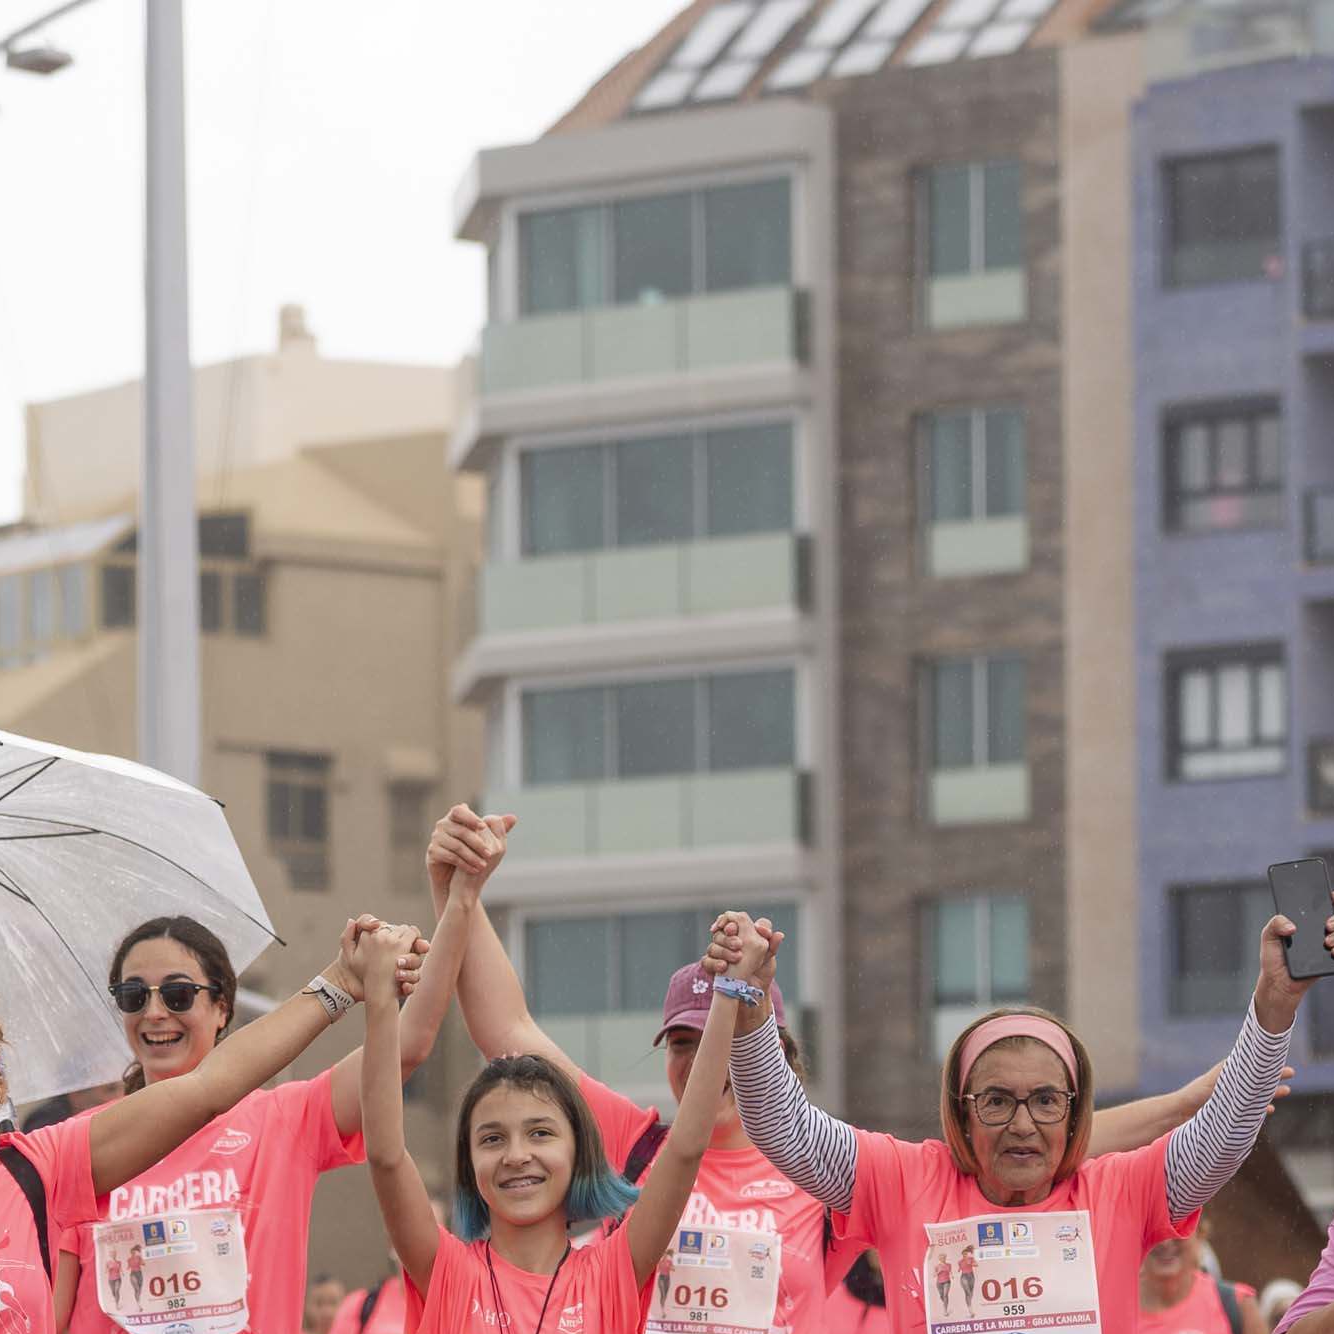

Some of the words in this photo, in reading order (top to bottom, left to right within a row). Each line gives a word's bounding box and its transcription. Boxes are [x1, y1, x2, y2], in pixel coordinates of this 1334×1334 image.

[110, 1168, 242, 1222] CARRERA
[937, 1232, 967, 1247] SUMA
[149, 1271, 201, 1297] 016
[981, 1276, 1044, 1302] 016
[167, 1297, 186, 1310] 982
[673, 1285, 729, 1308] 016
[689, 1311, 709, 1322] 981
[1003, 1304, 1025, 1316] 959
[935, 1324, 971, 1334] CARRERA
[974, 1323, 984, 1331] DE
[986, 1322, 997, 1330] LA
[998, 1320, 1025, 1330] MUJER
[1032, 1318, 1054, 1327] GRAN
[1056, 1315, 1091, 1325] CANARIA
